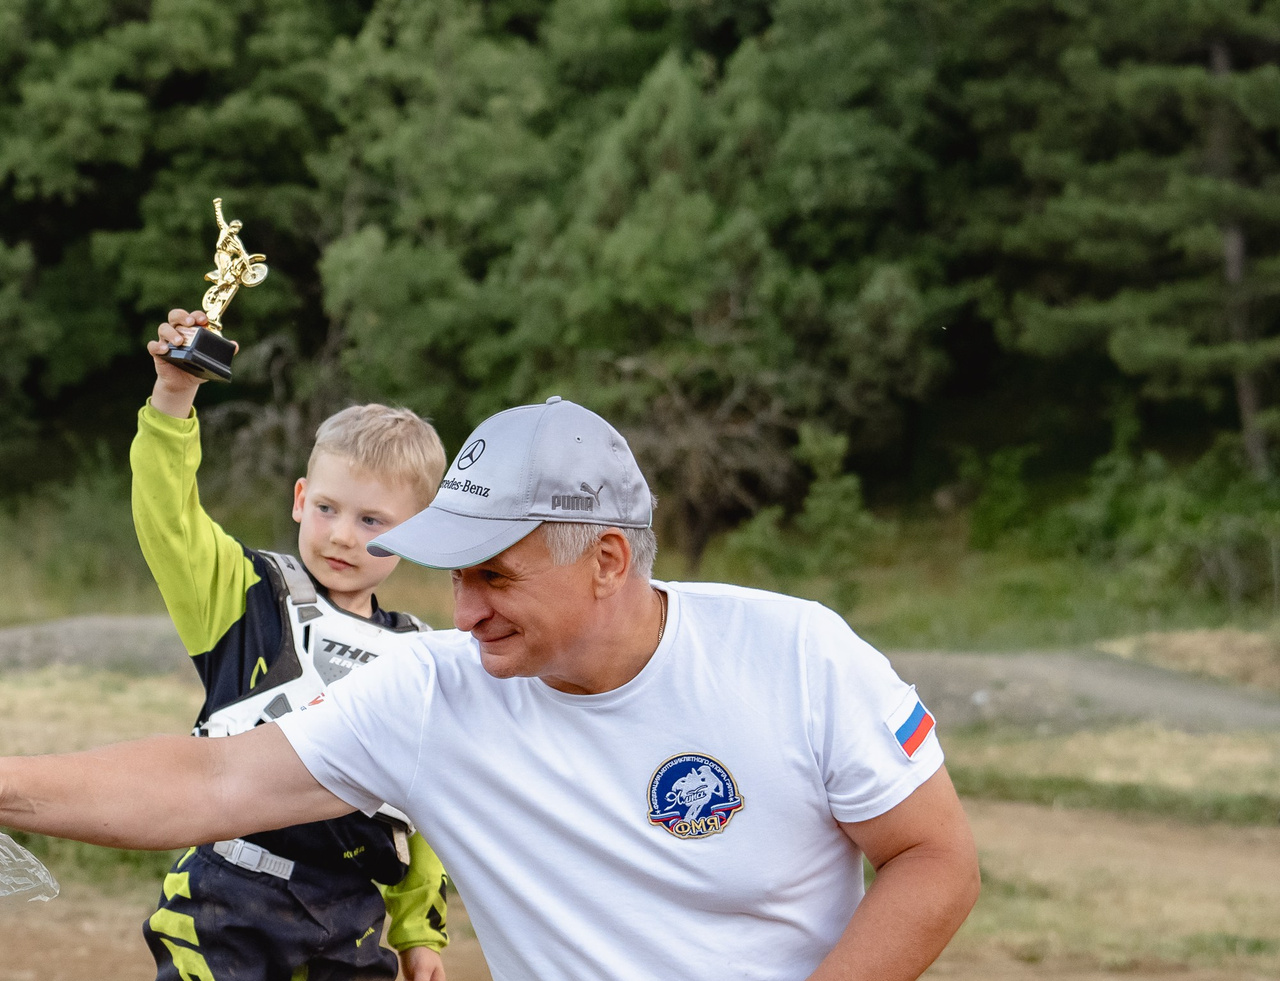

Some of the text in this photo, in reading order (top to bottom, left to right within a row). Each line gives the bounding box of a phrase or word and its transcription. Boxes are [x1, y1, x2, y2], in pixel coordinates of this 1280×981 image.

[551, 495, 594, 512] PUMA
[322, 638, 379, 664] THO
[675, 816, 720, 836] ФМЯ
